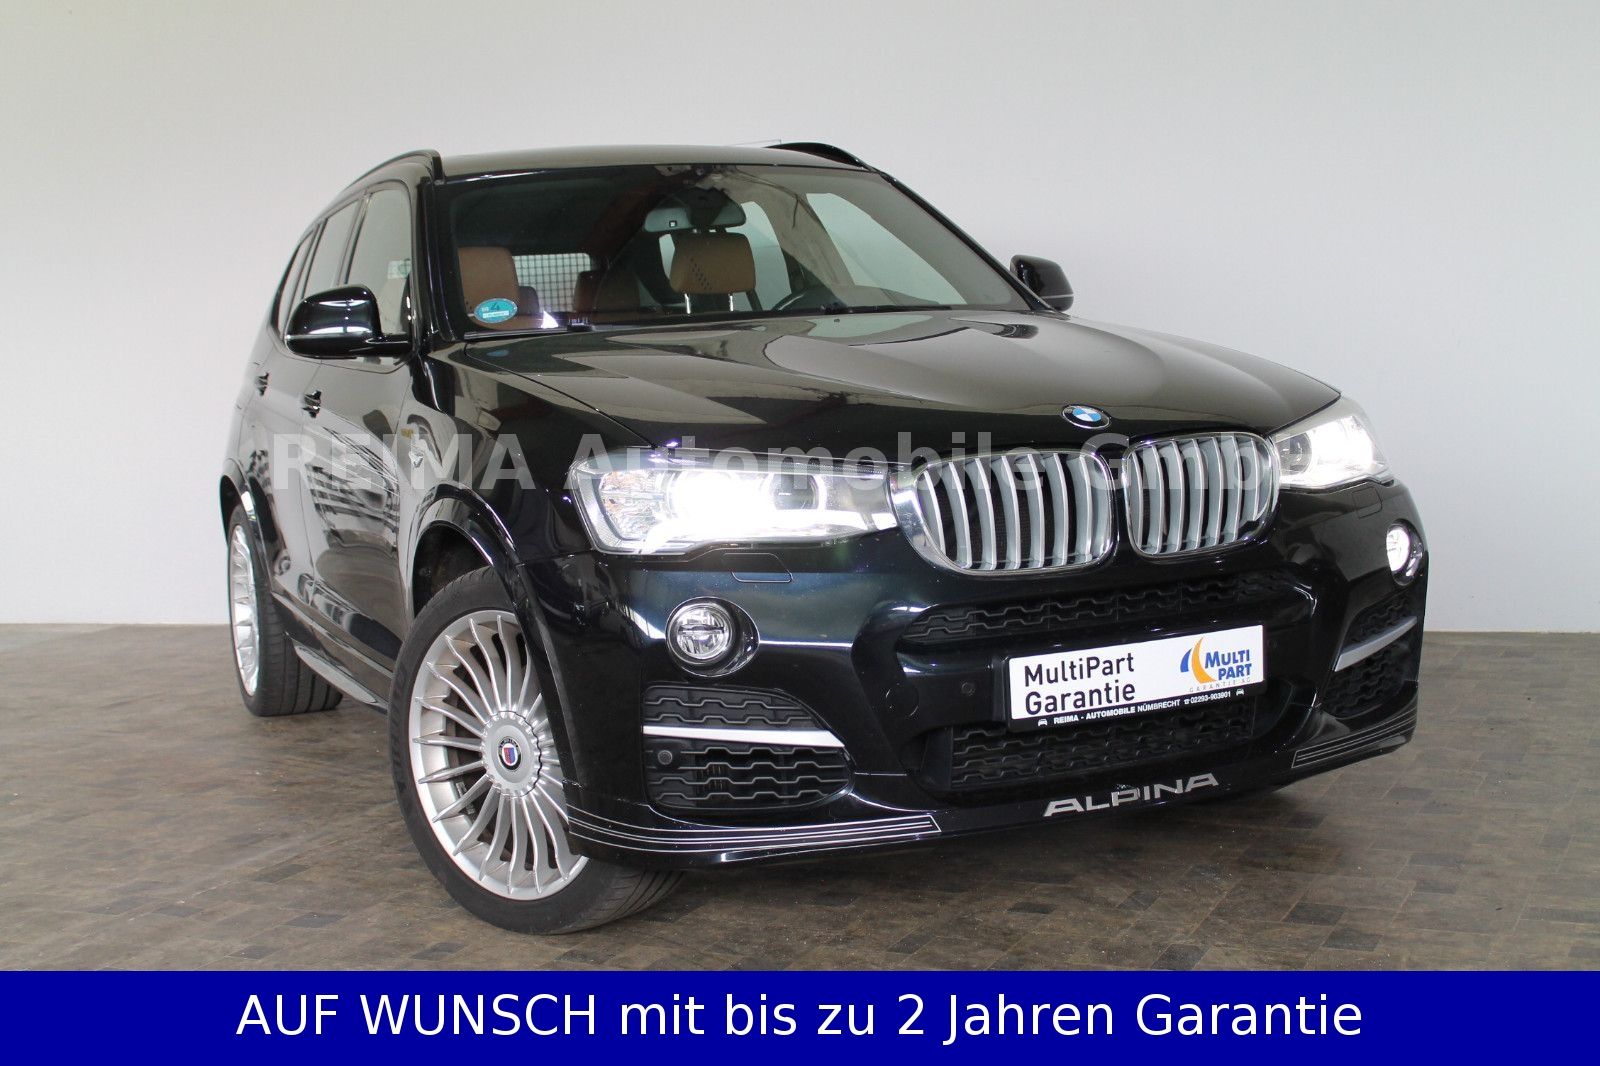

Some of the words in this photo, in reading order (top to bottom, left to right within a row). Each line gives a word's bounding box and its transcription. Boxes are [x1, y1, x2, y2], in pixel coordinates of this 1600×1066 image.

[1024, 652, 1134, 687] MultiPart
[1204, 649, 1250, 669] MULTI
[1218, 663, 1252, 680] PART
[1025, 679, 1135, 715] Garantie
[1053, 714, 1079, 725] REIMA
[1086, 705, 1135, 720] AUTOMOBILE
[1137, 698, 1180, 712] NÜMBRECHT
[1043, 772, 1219, 817] ALPINA
